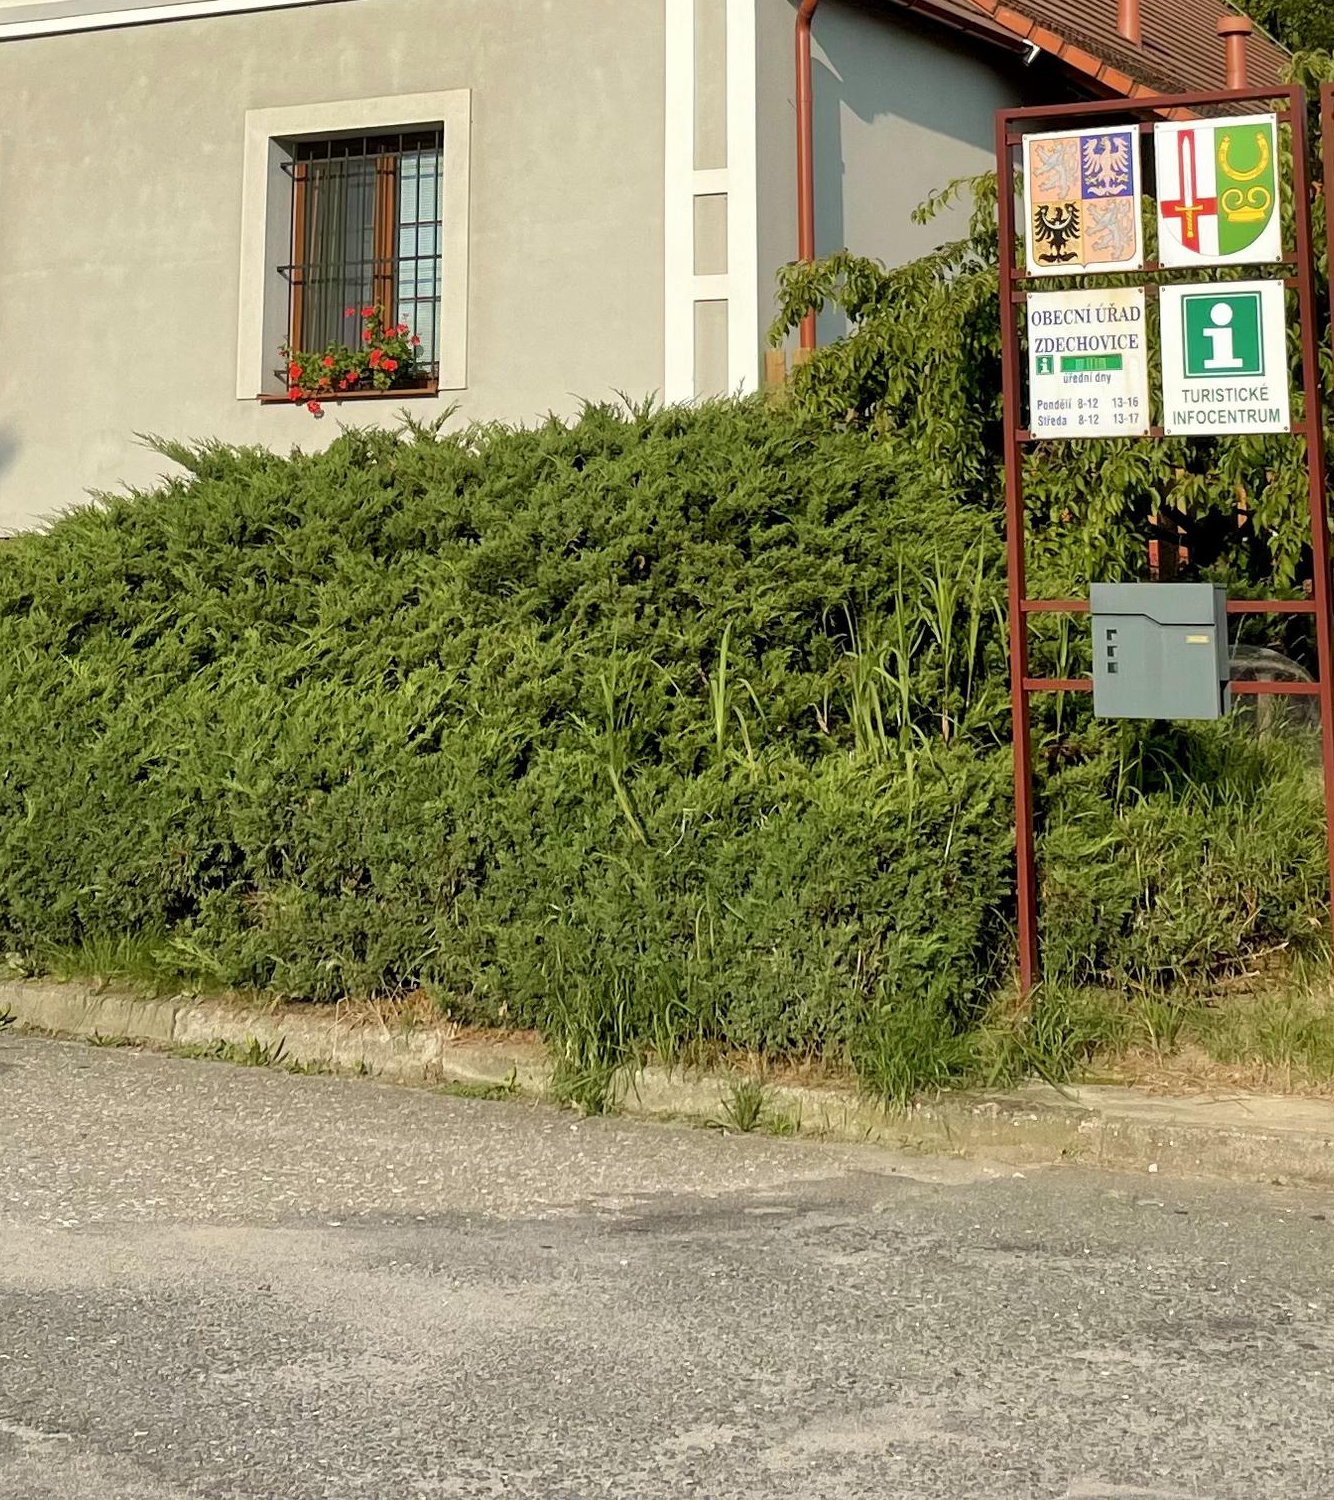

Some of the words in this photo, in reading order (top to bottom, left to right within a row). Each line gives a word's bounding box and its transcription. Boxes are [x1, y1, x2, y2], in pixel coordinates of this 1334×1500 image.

[1031, 303, 1091, 326] OBECNÍ
[1096, 302, 1141, 323] ÚŘAD
[1034, 334, 1139, 353] ZDECHOVICE
[1063, 373, 1093, 384] úřední
[1095, 372, 1112, 384] dny
[1181, 382, 1269, 403] TURISTICKÉ
[1037, 398, 1072, 410] Pondělí
[1077, 398, 1099, 409] 8-12
[1111, 397, 1139, 408] 13-16
[1038, 415, 1067, 426] Středa
[1078, 414, 1099, 425] 8-12
[1113, 413, 1139, 424] 13-17
[1173, 408, 1281, 425] INFOCENTRUM
